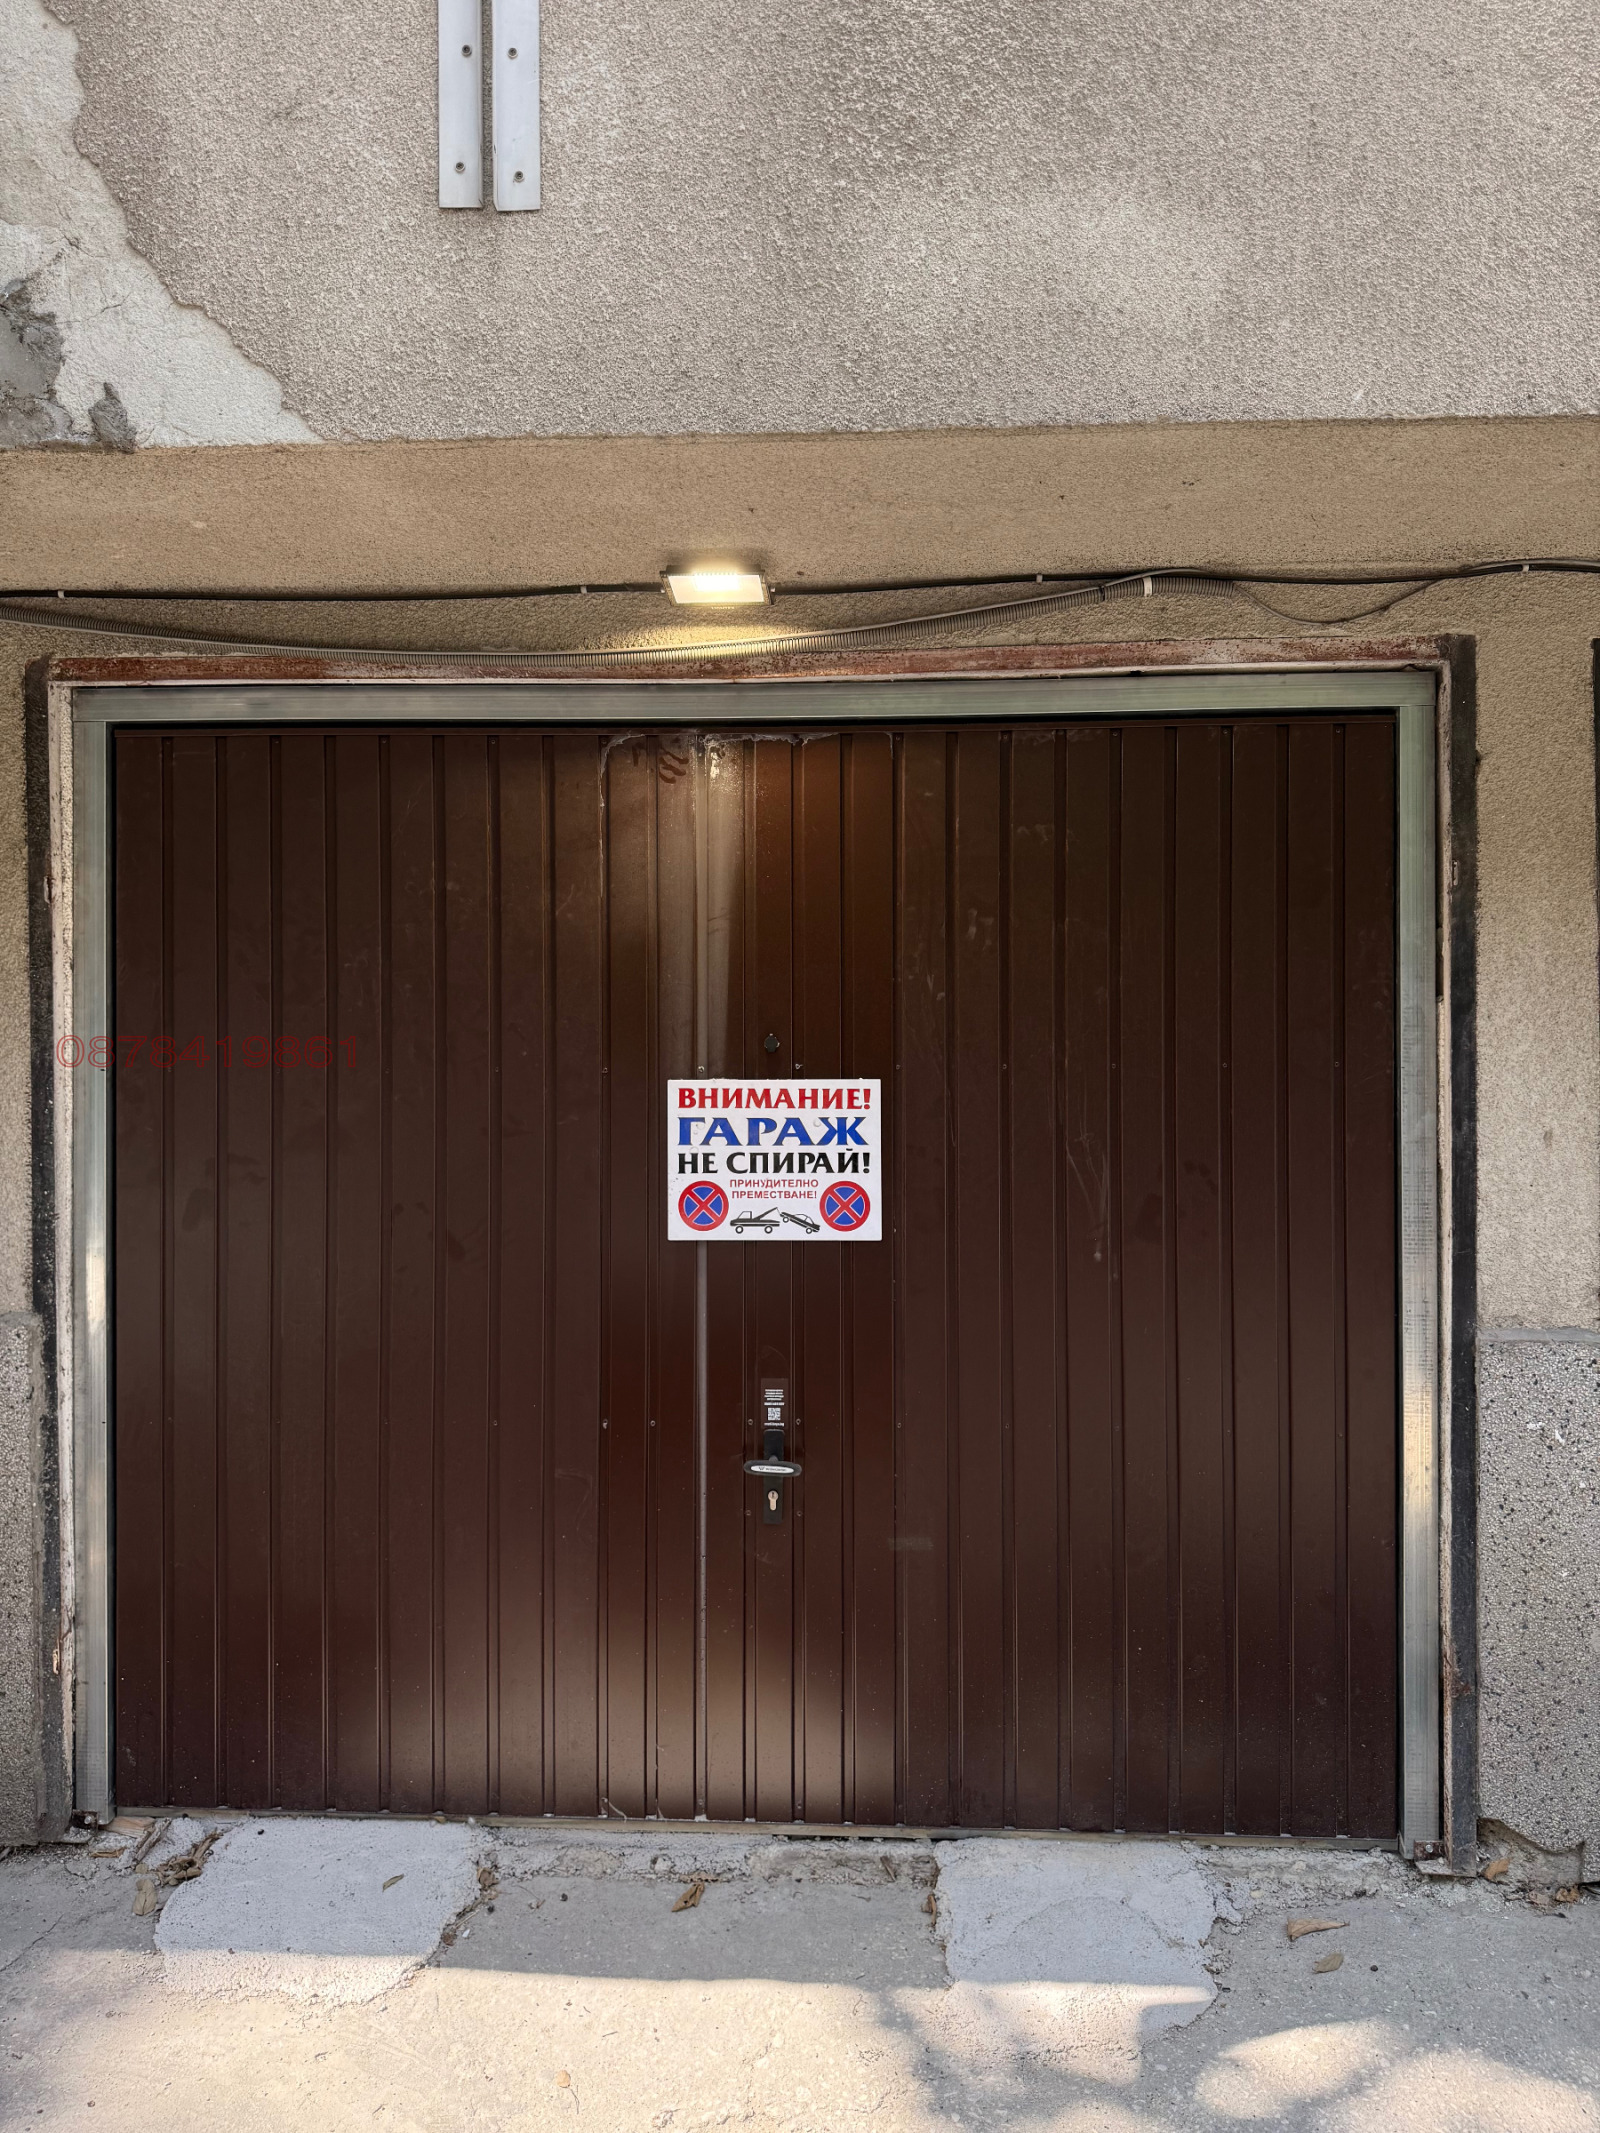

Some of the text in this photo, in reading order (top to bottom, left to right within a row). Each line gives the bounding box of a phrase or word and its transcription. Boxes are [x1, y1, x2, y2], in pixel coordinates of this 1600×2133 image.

[677, 1088, 871, 1110] ВНИМАНИЕ!
[677, 1117, 869, 1146] ГАРАЖ
[677, 1148, 871, 1174] НЕ СПИРАЙ!
[729, 1179, 819, 1188] ПРИНУДИТЕЛНО
[731, 1190, 817, 1199] ПРЕМЕСТВАНЕ!
